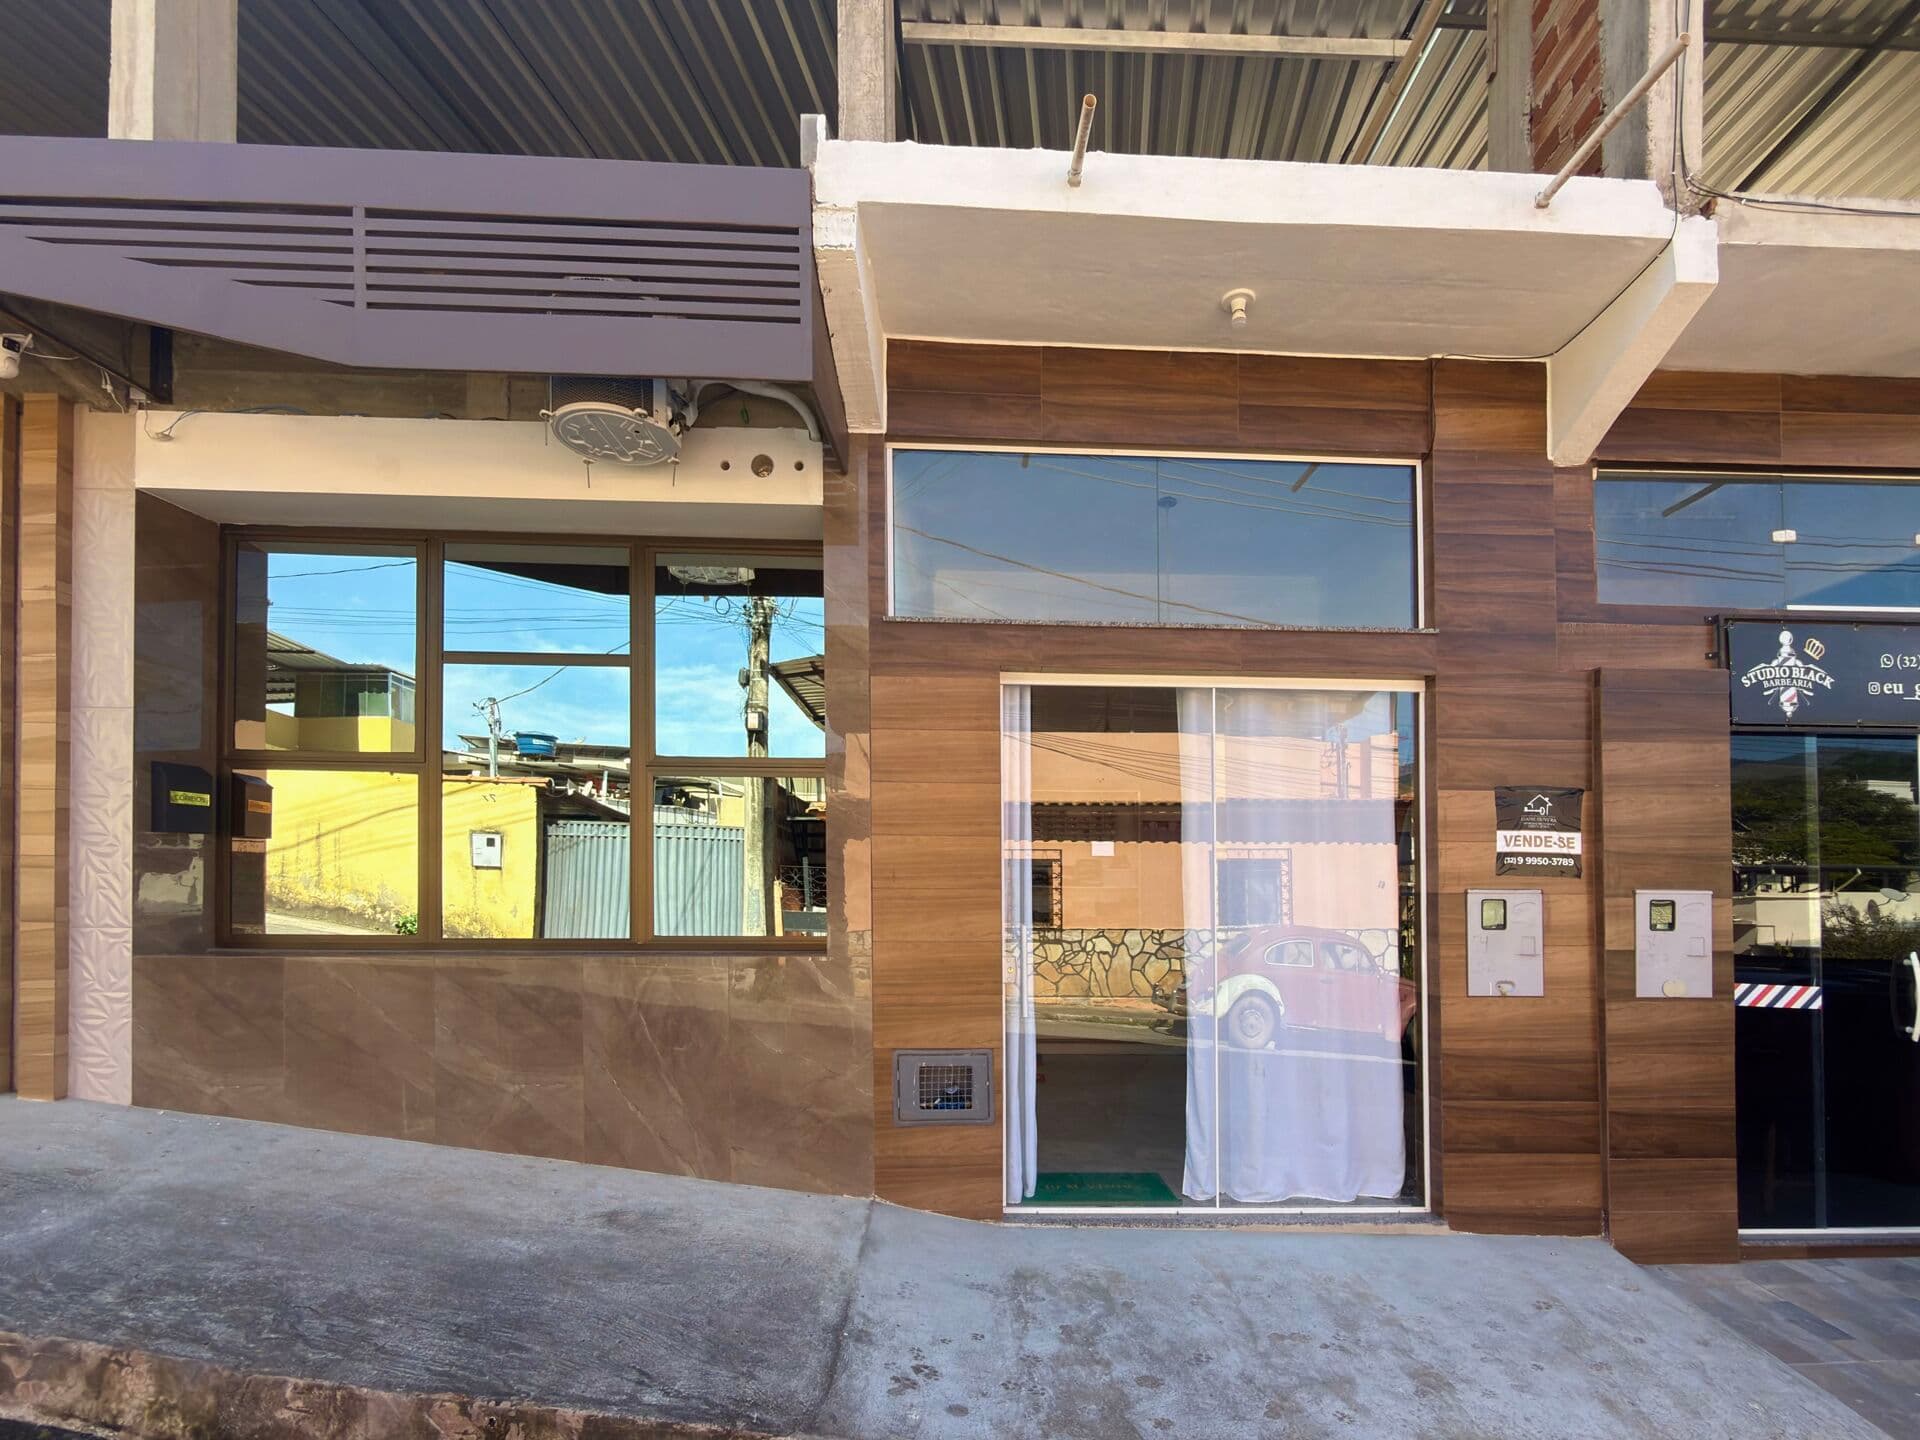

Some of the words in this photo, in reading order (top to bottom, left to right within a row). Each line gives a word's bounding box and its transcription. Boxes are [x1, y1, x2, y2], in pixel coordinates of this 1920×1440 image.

[1741, 666, 1790, 688] STUDIO
[1791, 667, 1836, 690] BLACK
[1763, 678, 1813, 689] BARBEARIA
[1503, 834, 1576, 849] VENDE-SE
[1517, 856, 1524, 865] 9
[1525, 857, 1575, 866] 9950-3789
